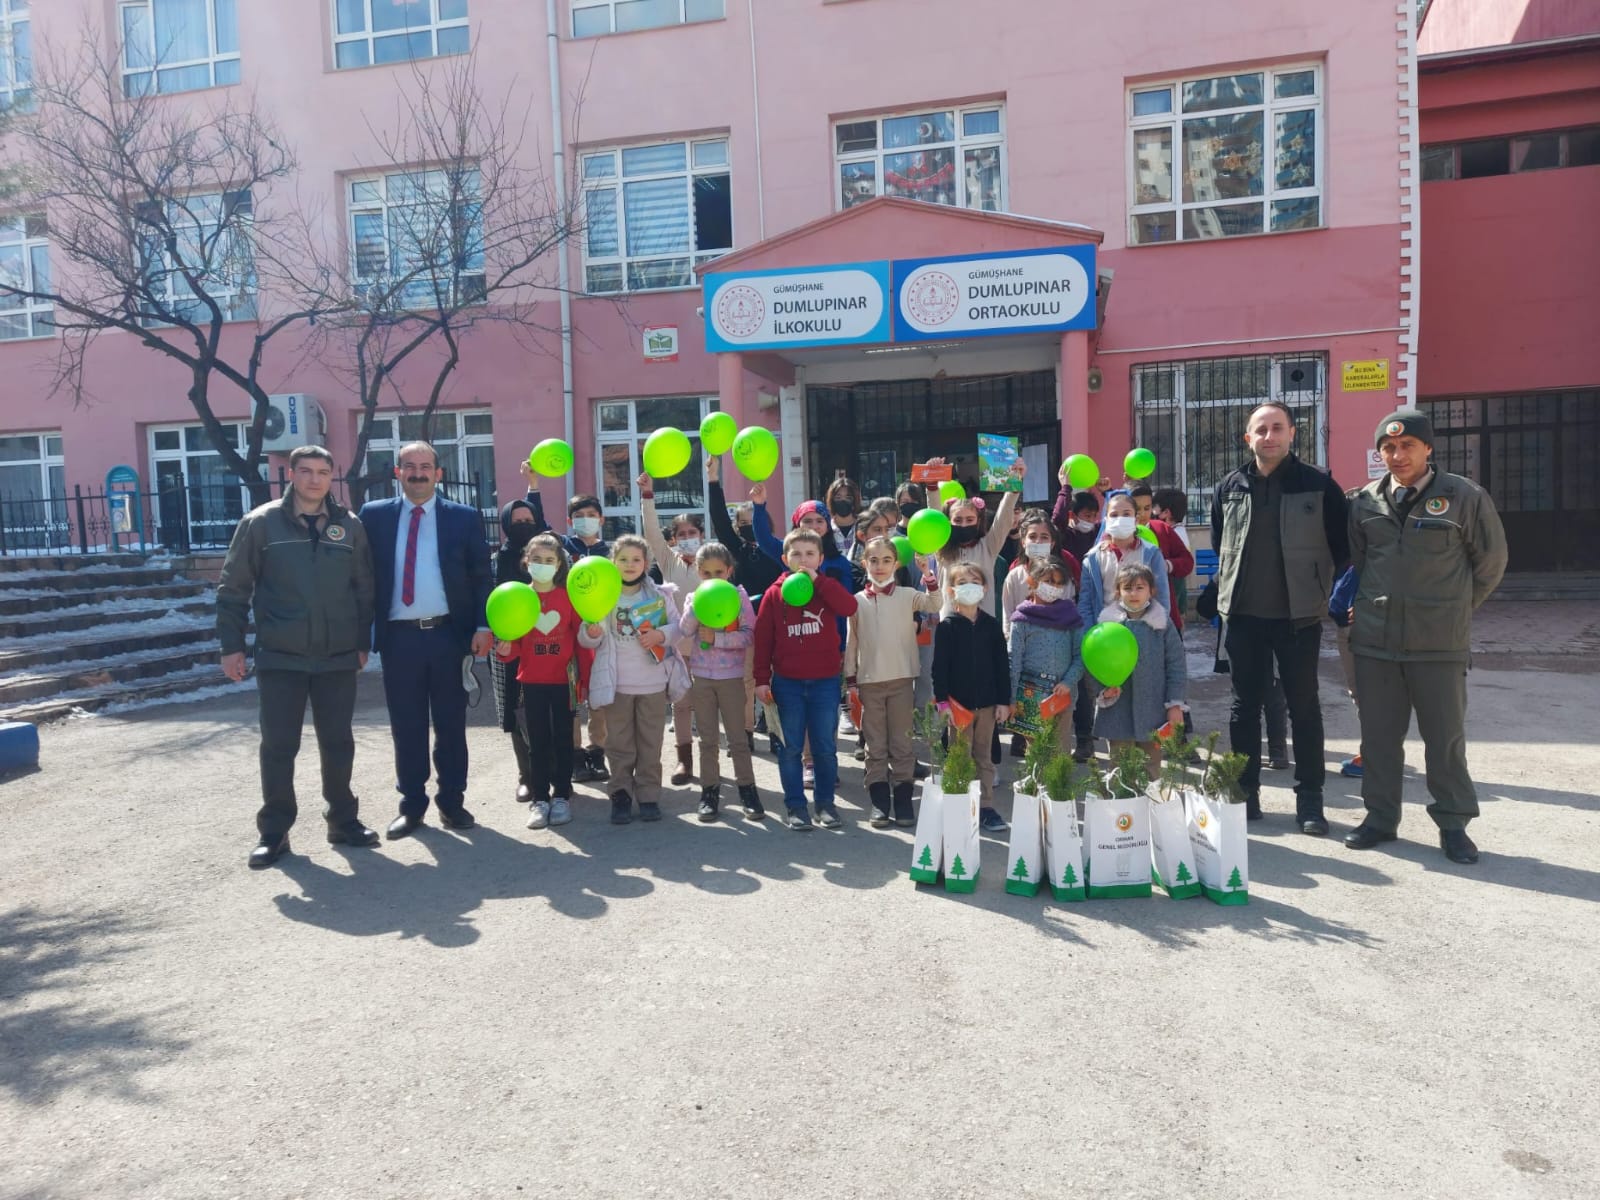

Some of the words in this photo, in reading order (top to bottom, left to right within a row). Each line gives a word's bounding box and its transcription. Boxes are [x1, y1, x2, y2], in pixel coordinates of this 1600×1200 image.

[968, 267, 1024, 280] GÜMÜŞHANE
[773, 282, 825, 294] GÜMÜŞHANE
[968, 279, 1071, 300] DUMLUPINAR
[773, 296, 868, 315] DUMLUPINAR
[968, 301, 1061, 321] ORTAOKULU
[773, 318, 842, 335] İLKOKULU
[787, 621, 820, 638] PUMA
